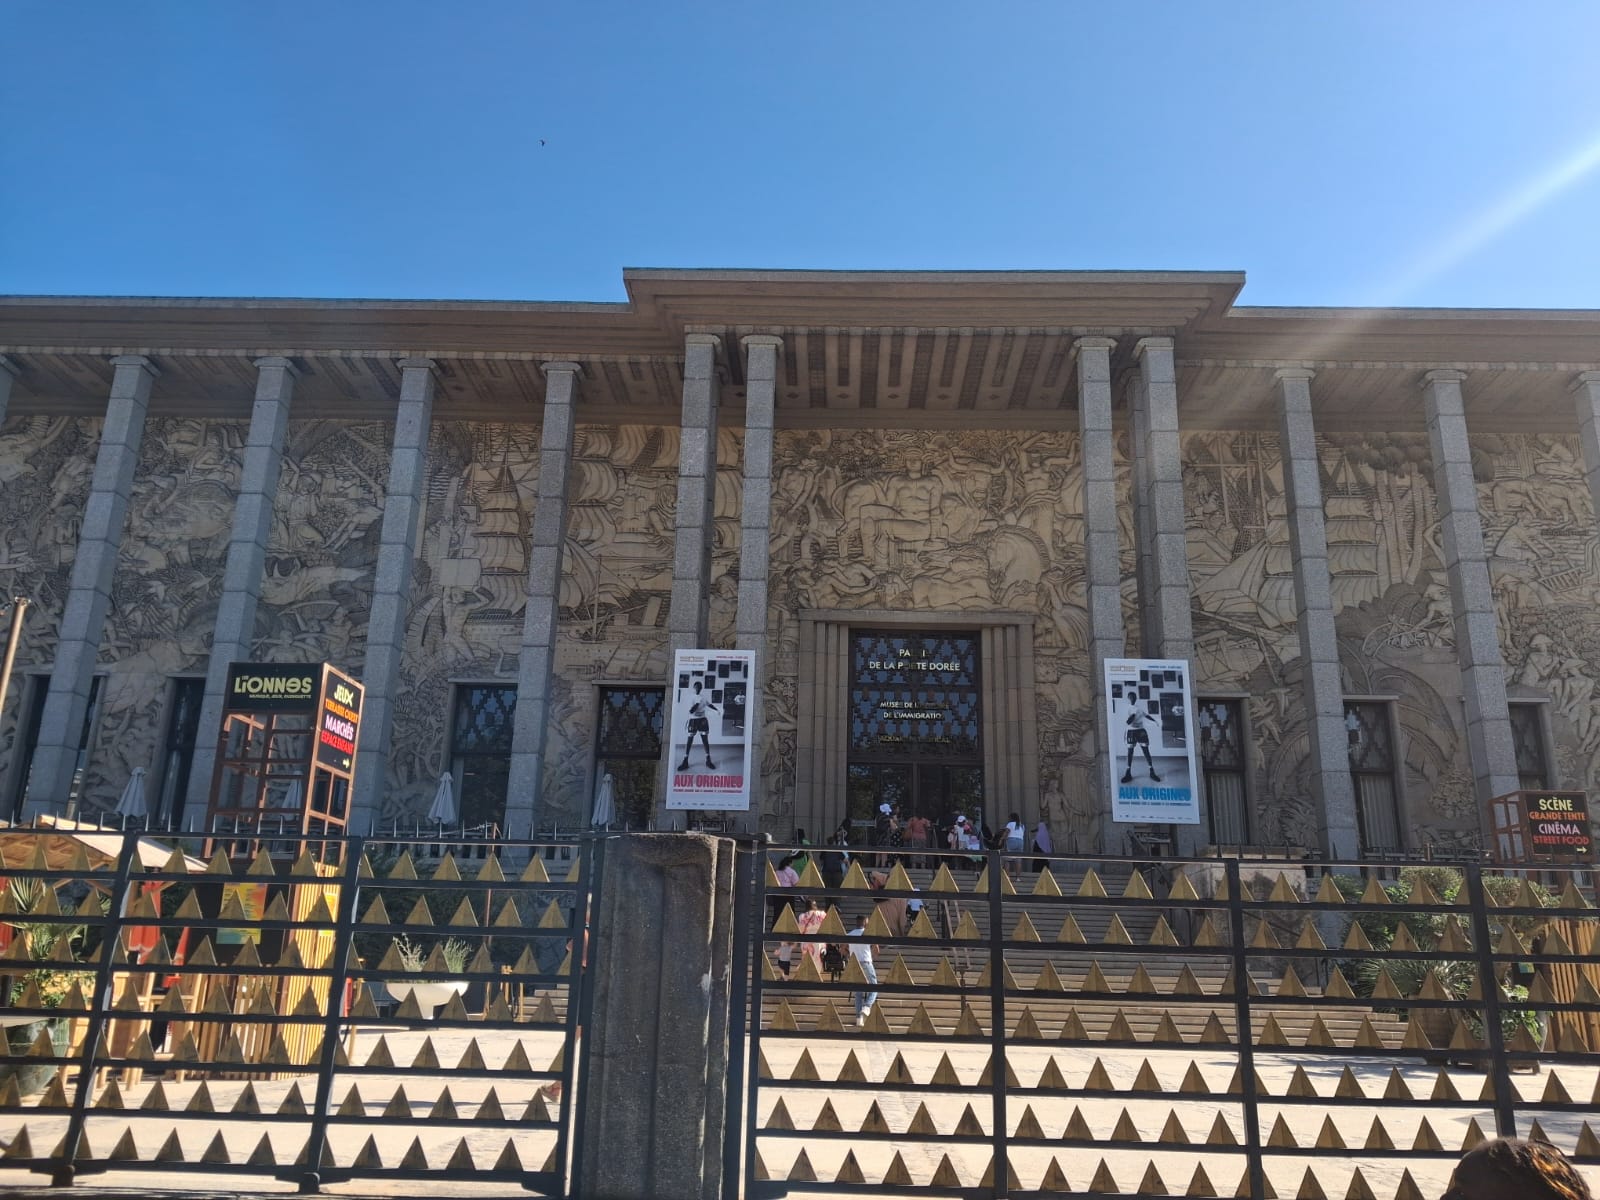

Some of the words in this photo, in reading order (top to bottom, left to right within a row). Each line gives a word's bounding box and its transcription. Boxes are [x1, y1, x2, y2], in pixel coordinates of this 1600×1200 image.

[869, 661, 881, 669] DE
[883, 662, 895, 670] LA
[898, 662, 927, 670] PTE
[929, 660, 960, 671] DORÉE
[334, 684, 354, 707] JEUX
[325, 713, 354, 741] MARCHÉS
[673, 774, 694, 787] AUX
[1119, 786, 1140, 799] AUX
[1538, 796, 1573, 811] SCÈNE
[1529, 811, 1562, 820] GRANDE
[1563, 812, 1586, 821] TENTE
[1538, 821, 1580, 835] CINÉMA
[1533, 835, 1560, 844] STREET
[1562, 836, 1589, 845] FOOD
